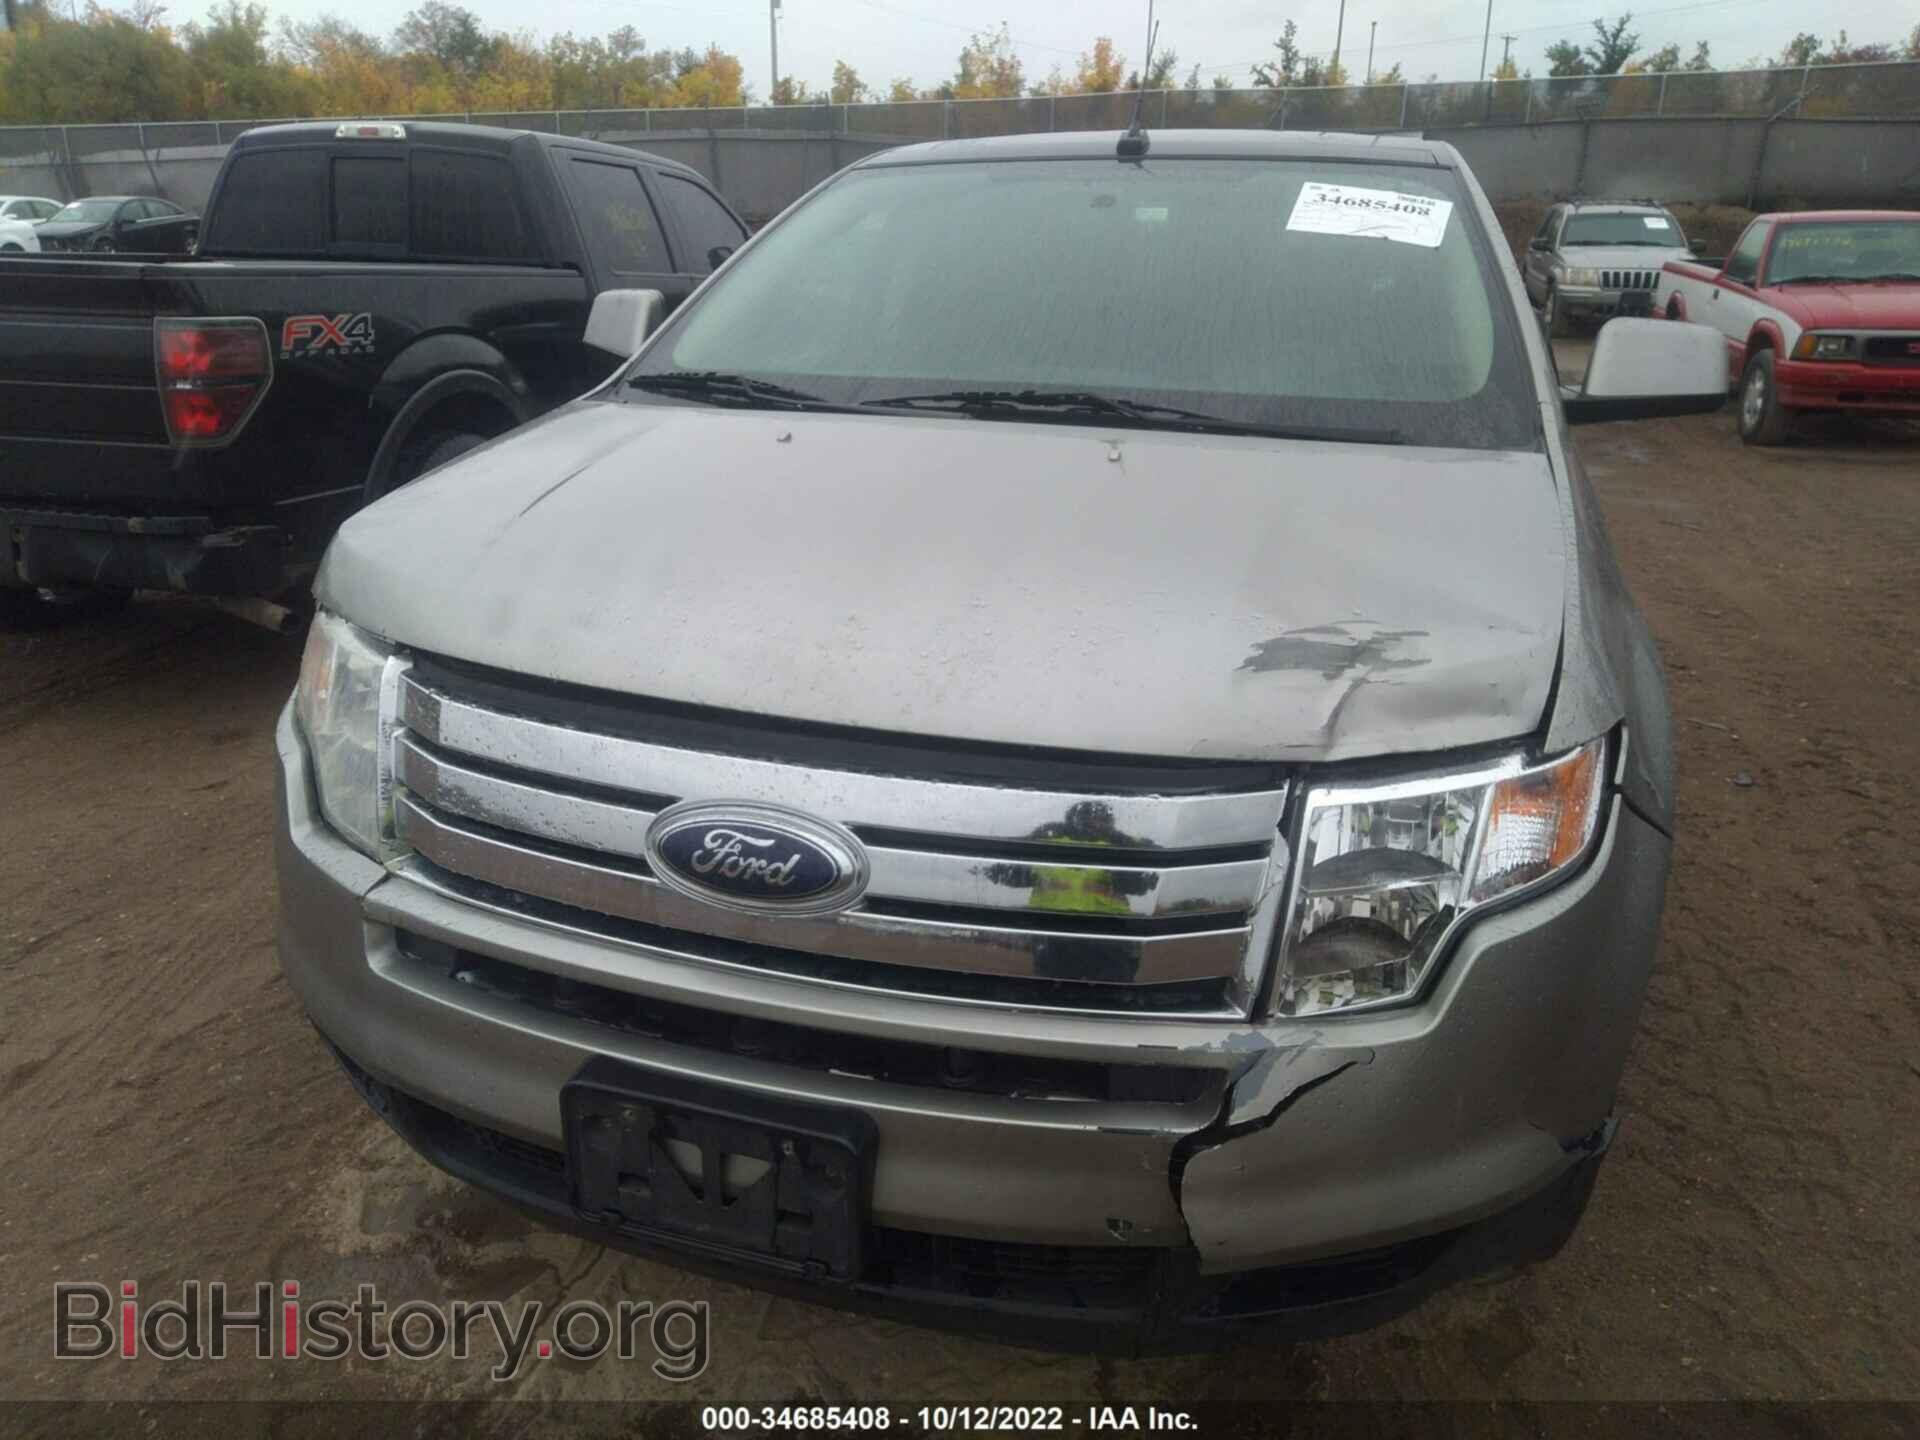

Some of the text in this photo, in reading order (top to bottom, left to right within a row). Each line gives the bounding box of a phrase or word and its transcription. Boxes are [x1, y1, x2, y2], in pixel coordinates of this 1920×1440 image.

[1313, 193, 1431, 216] 34685408
[282, 312, 375, 351] FX4
[691, 828, 801, 886] Ford
